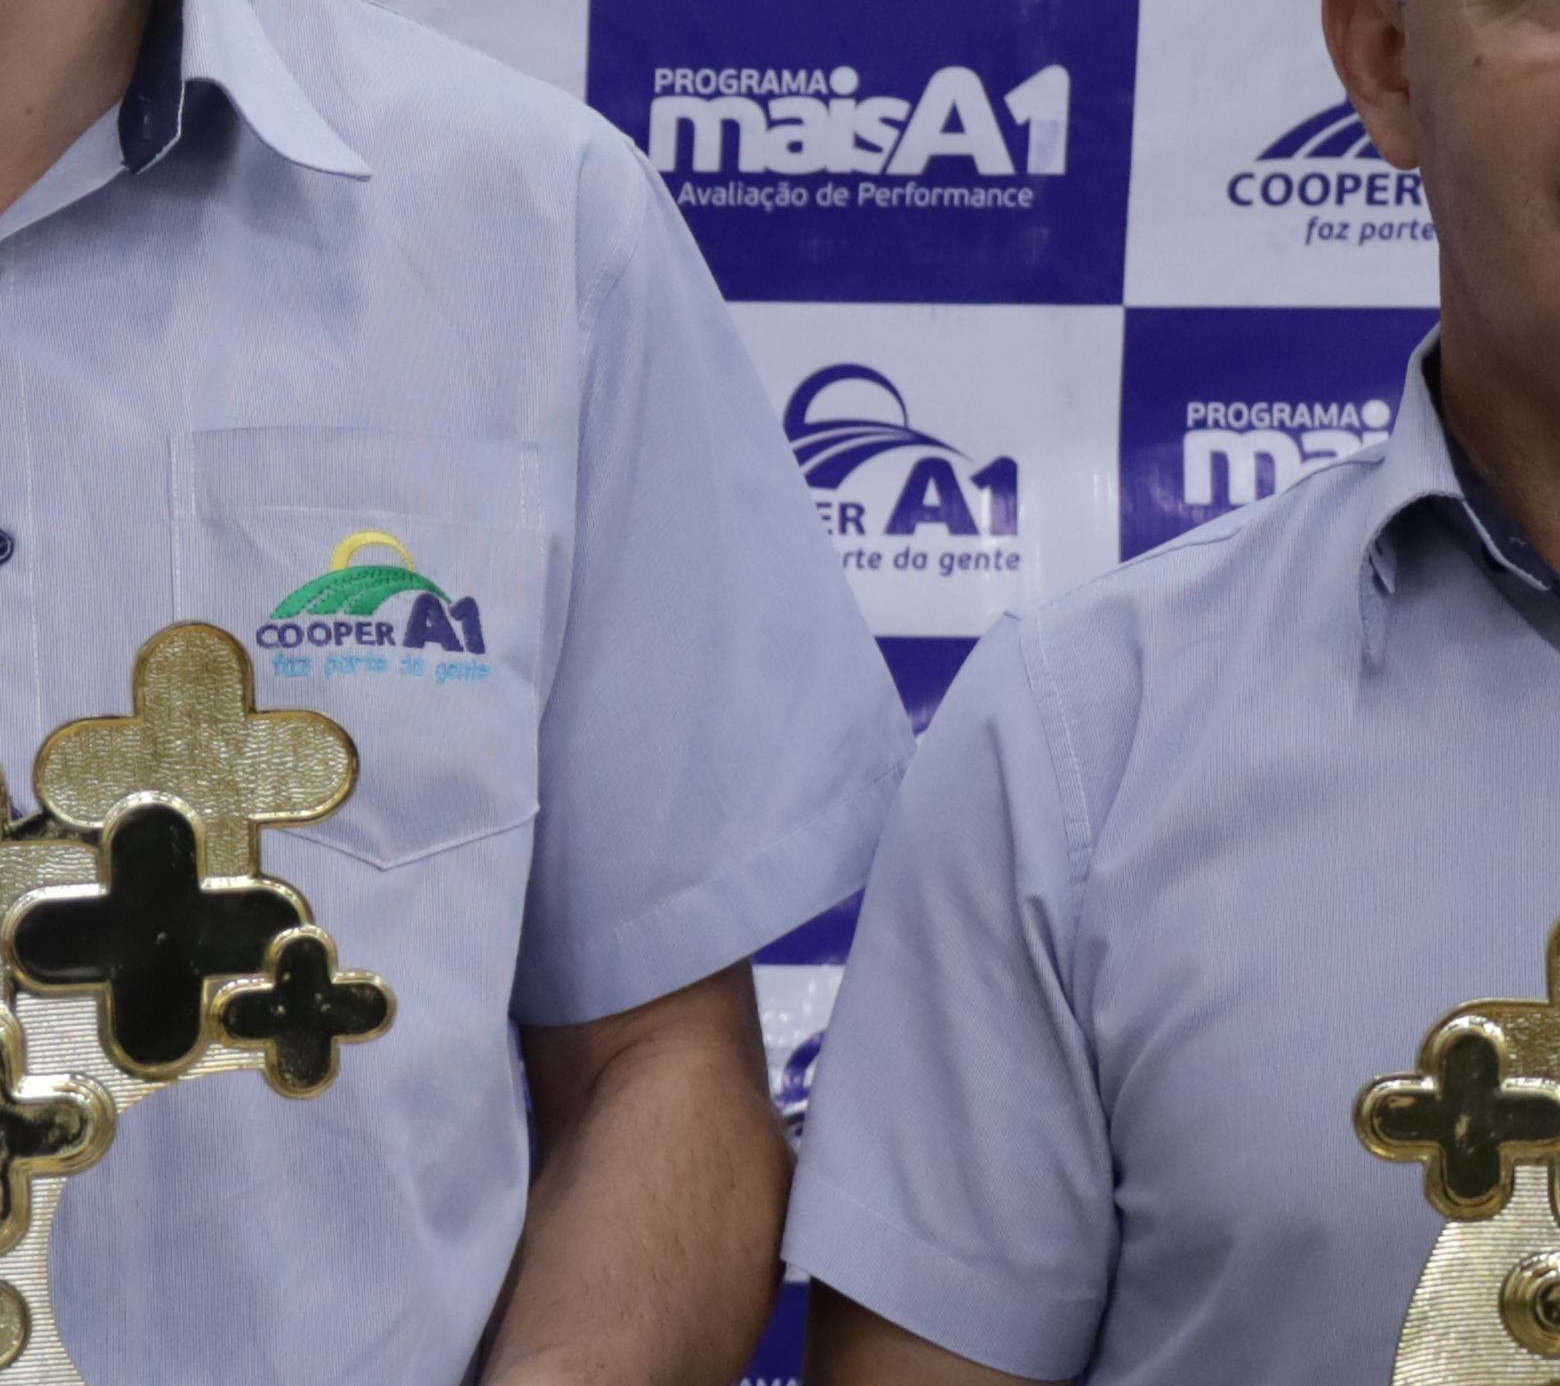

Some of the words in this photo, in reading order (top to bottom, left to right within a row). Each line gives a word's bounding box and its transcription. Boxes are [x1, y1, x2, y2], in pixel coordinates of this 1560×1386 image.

[655, 68, 828, 95] PROGRAMA
[679, 180, 808, 212] Avaliação
[816, 181, 848, 206] de
[858, 180, 1034, 207] Performance
[256, 621, 396, 649] COOPER
[402, 593, 486, 654] A1
